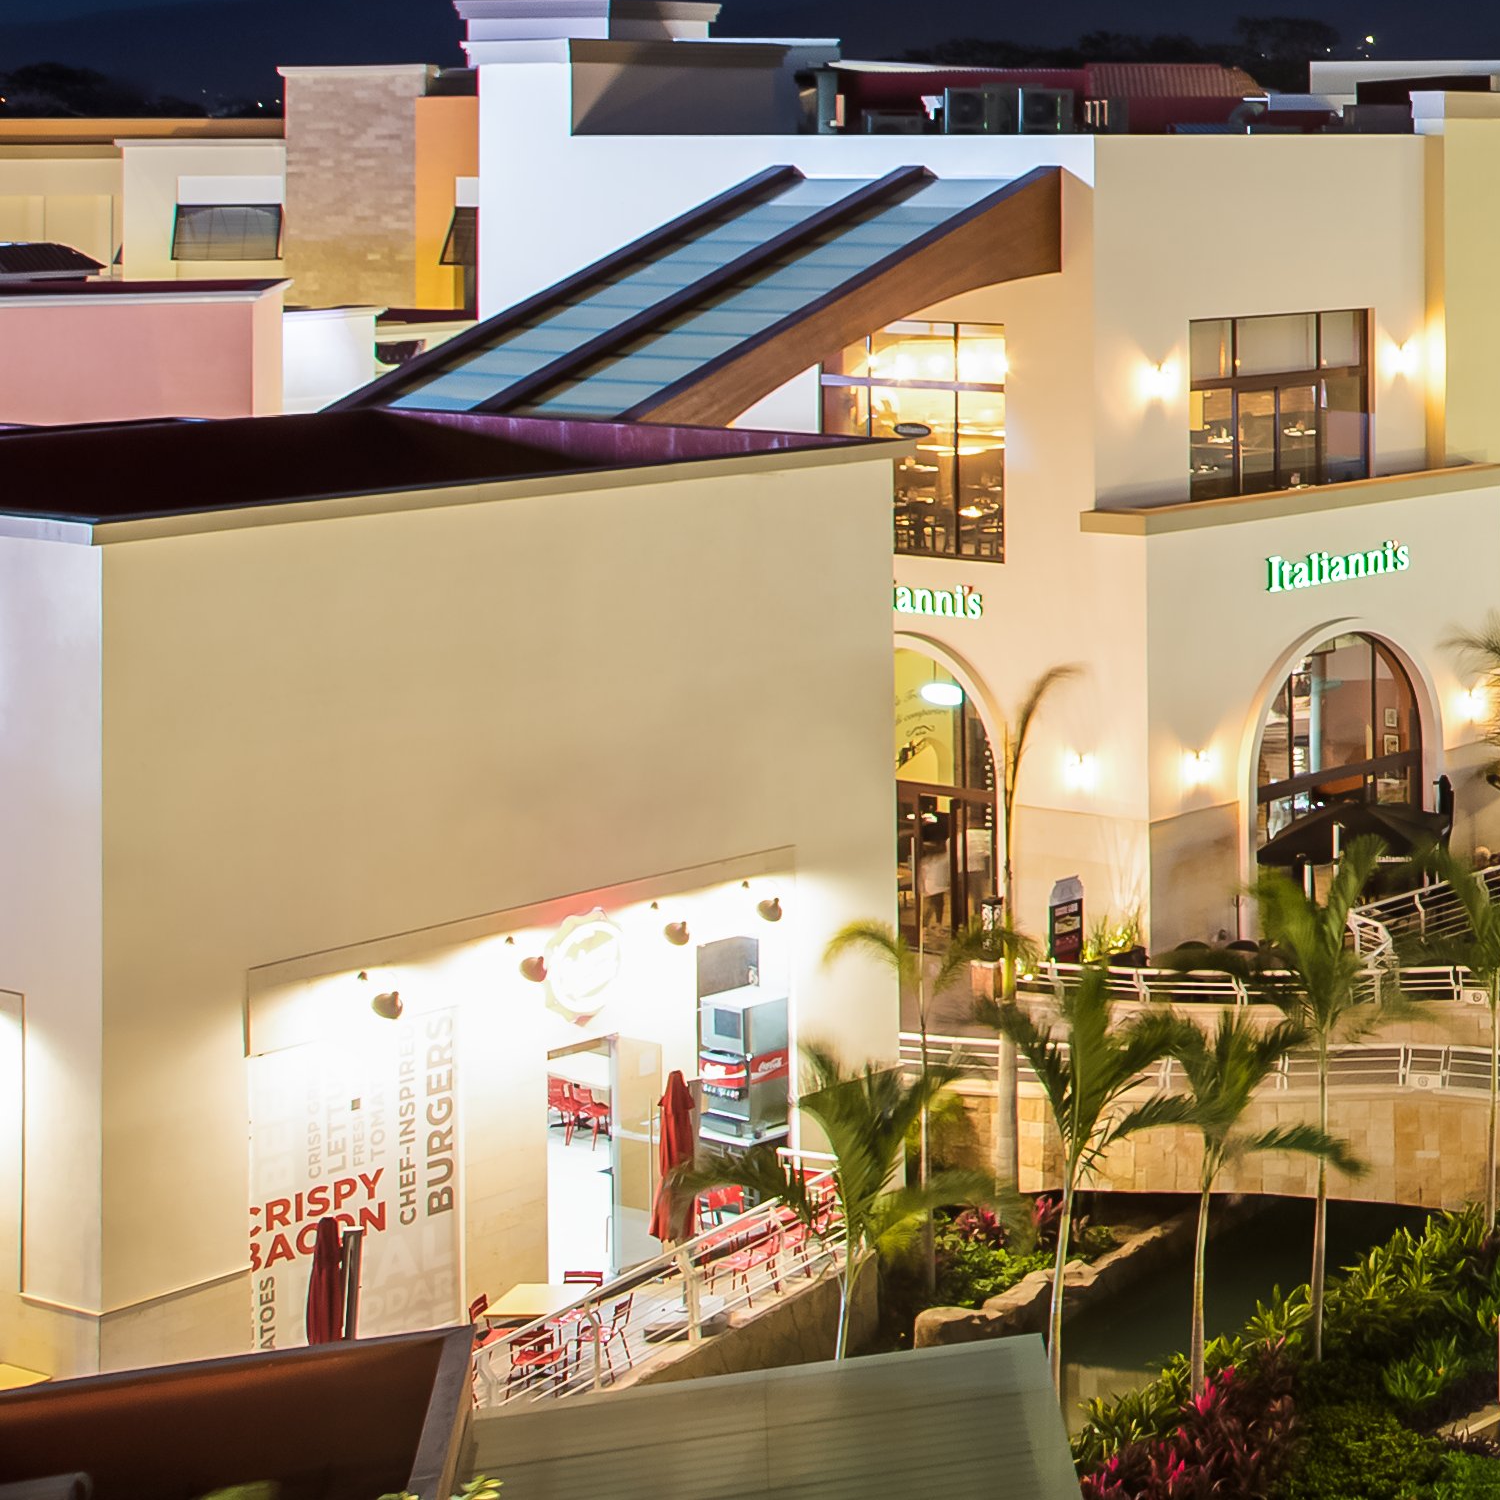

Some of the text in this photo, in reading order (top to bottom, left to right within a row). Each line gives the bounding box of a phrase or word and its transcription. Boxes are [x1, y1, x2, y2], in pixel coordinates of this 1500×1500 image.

[1265, 540, 1410, 593] Italianni's
[893, 580, 983, 621] anni's
[426, 1013, 455, 1218] BURGERS
[307, 1120, 322, 1180] CRISP
